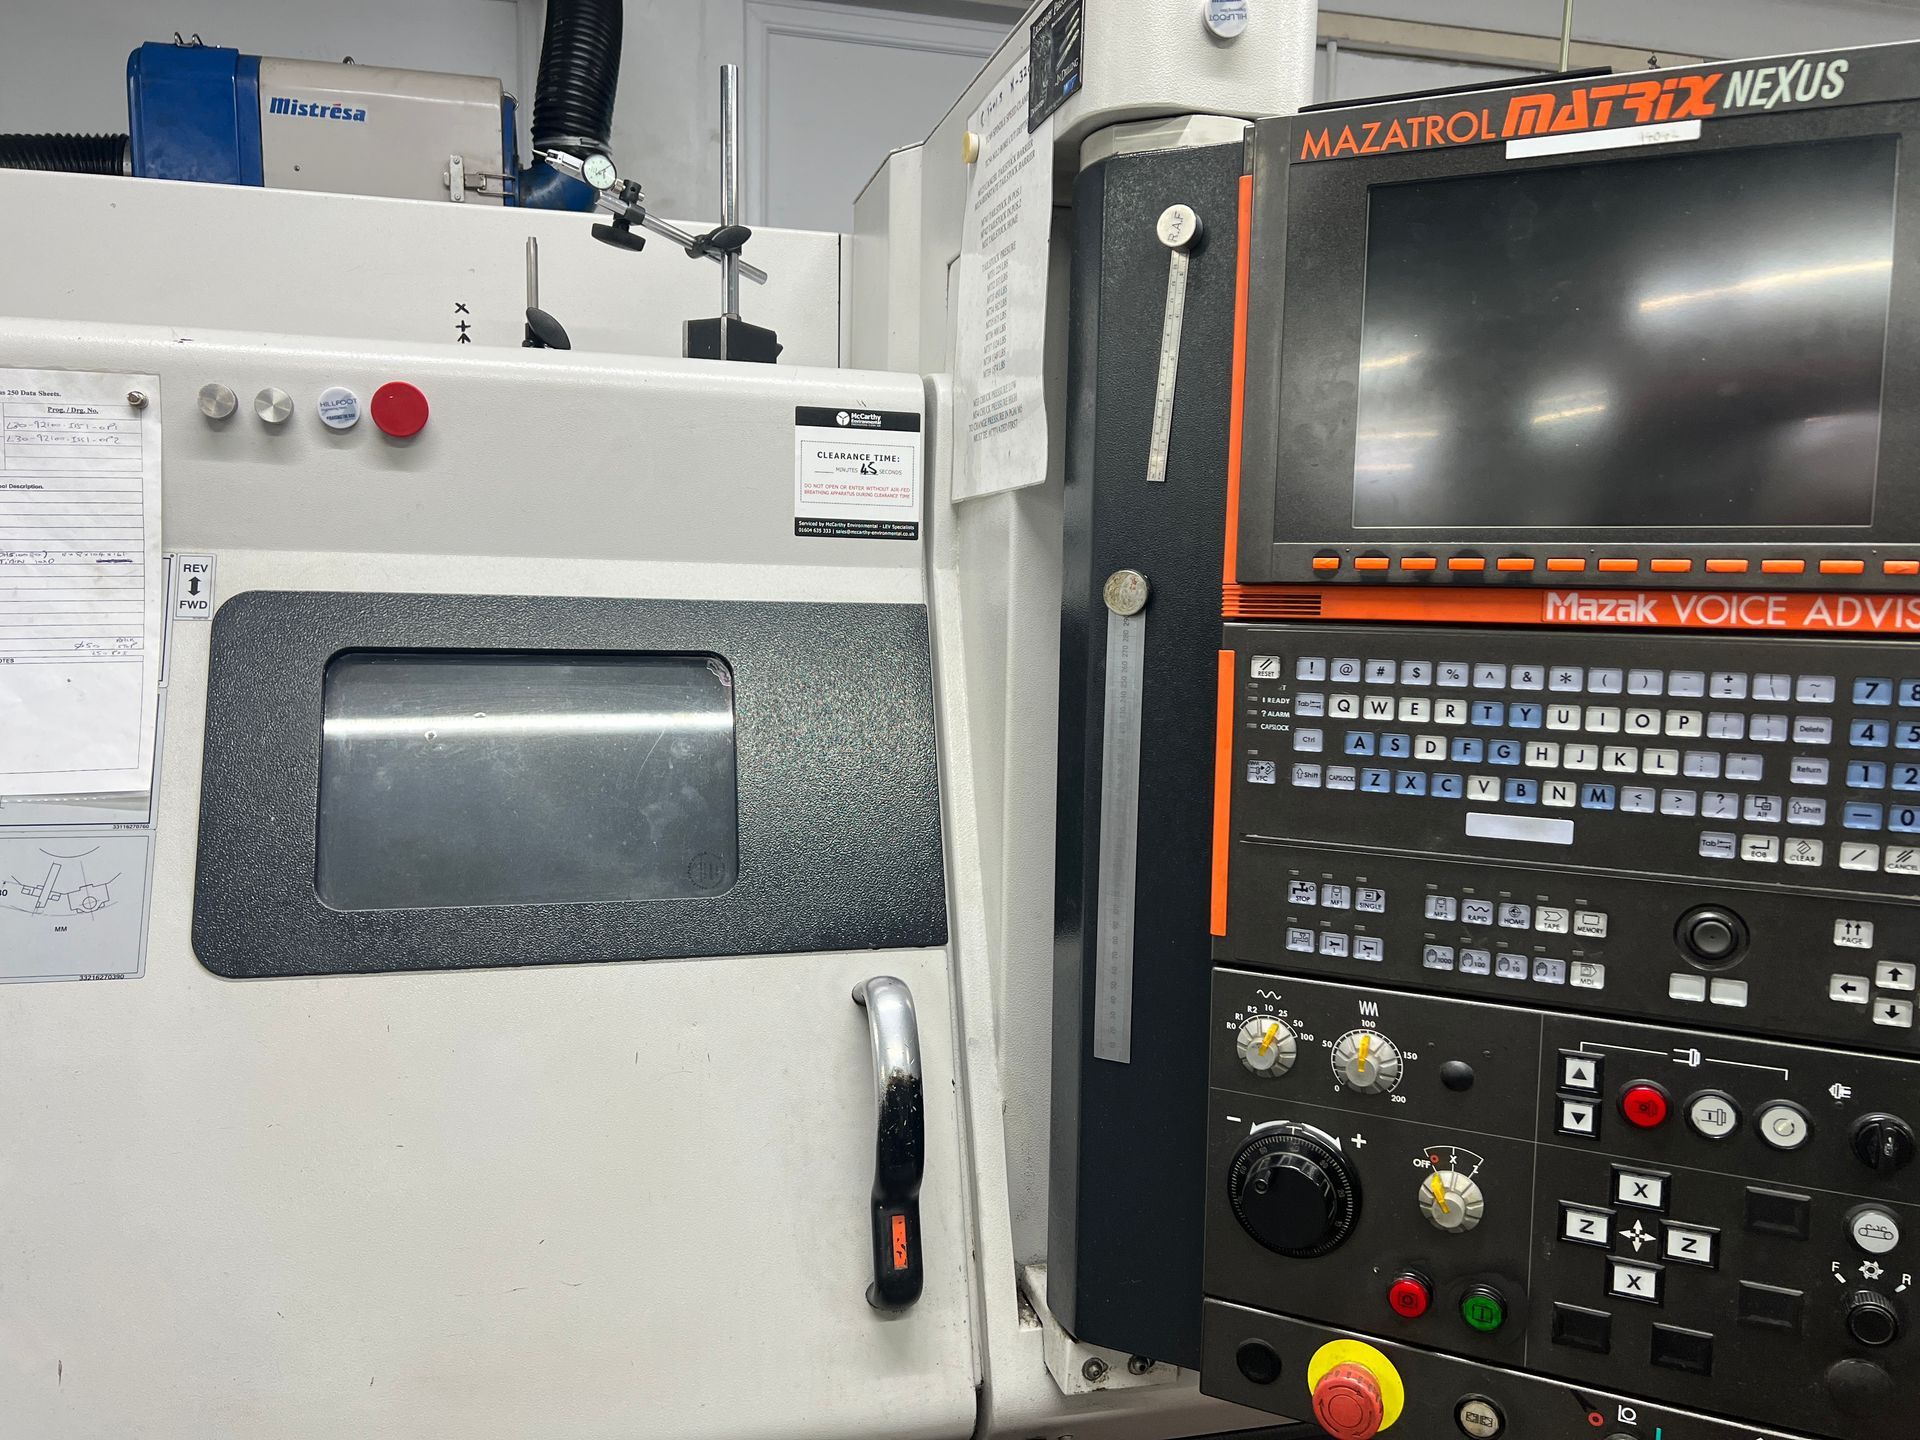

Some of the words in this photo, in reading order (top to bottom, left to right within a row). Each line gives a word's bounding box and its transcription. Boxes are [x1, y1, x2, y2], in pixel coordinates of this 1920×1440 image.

[1301, 109, 1497, 162] MAZATROL
[1501, 72, 1725, 138] MATRIX
[1723, 57, 1850, 110] NEXUS
[1017, 139, 1034, 162] BARRIER
[1018, 150, 1035, 173] BARRIER
[320, 398, 357, 407] HILLFOOT
[851, 412, 881, 421] McCarthy
[817, 451, 870, 461] CLEARANCE
[874, 454, 900, 463] TIME:
[183, 563, 209, 573] REV
[179, 600, 208, 609] FWD
[1546, 591, 1659, 624] Mazak
[1671, 594, 1787, 626] VOICE
[1866, 683, 1879, 699] 7
[1911, 684, 1920, 701] 8
[1267, 697, 1291, 705] READY
[1337, 699, 1350, 712] Q
[1371, 701, 1388, 714] W
[1411, 703, 1419, 715] E
[1446, 704, 1455, 717] R
[1483, 707, 1492, 719] T
[1520, 708, 1532, 721] Y
[1558, 710, 1569, 724] U
[1600, 712, 1605, 726] I
[1635, 714, 1650, 728] O
[1679, 716, 1689, 729] P
[1799, 725, 1825, 734] Delete
[1861, 724, 1875, 741] 4
[1907, 726, 1920, 743] 5
[1353, 736, 1366, 749] A
[1390, 738, 1400, 751] S
[1426, 741, 1436, 754] D
[1463, 743, 1471, 755] F
[1497, 745, 1511, 759] G
[1536, 747, 1548, 761] H
[1576, 750, 1584, 763] J
[1615, 752, 1626, 766] K
[1657, 754, 1665, 768] L
[1797, 766, 1822, 774] Return
[1862, 766, 1869, 781] 1
[1905, 768, 1918, 784] 2
[1328, 774, 1356, 782] CAPSLOCK
[1370, 774, 1381, 786] Z
[1405, 776, 1417, 789] X
[1441, 778, 1452, 792] C
[1478, 780, 1490, 794] V
[1516, 784, 1526, 797] B
[1553, 787, 1566, 800] N
[1590, 789, 1607, 803] M
[1901, 809, 1915, 826] 0
[1790, 854, 1816, 862] CLEAR
[1888, 863, 1919, 871] CANCEL
[1295, 895, 1311, 903] STOP
[1359, 902, 1383, 911] SINGLE
[1467, 915, 1489, 923] RAPID
[1504, 918, 1525, 926] HOME
[1543, 922, 1560, 931] TAPE
[1577, 926, 1604, 935] MEMORY
[1841, 936, 1863, 945] PAGE
[1579, 978, 1595, 986] MDI
[1247, 1005, 1258, 1014] R2
[1264, 1003, 1274, 1012] 10
[1278, 1009, 1288, 1018] 25
[1235, 1013, 1244, 1022] R1
[1293, 1019, 1304, 1029] 50
[1361, 1019, 1376, 1029] 100
[1300, 1032, 1315, 1042] 100
[1322, 1039, 1333, 1049] 50
[1403, 1051, 1418, 1061] 150
[1334, 1084, 1340, 1093] 0
[1391, 1094, 1407, 1104] 200
[1413, 1158, 1431, 1169] OFF
[1449, 1154, 1457, 1165] X
[1633, 1182, 1649, 1199] X
[1579, 1219, 1595, 1235] Z
[1681, 1237, 1698, 1254] Z
[1831, 1261, 1840, 1273] F
[1626, 1274, 1642, 1291] X
[1903, 1274, 1912, 1285] R
